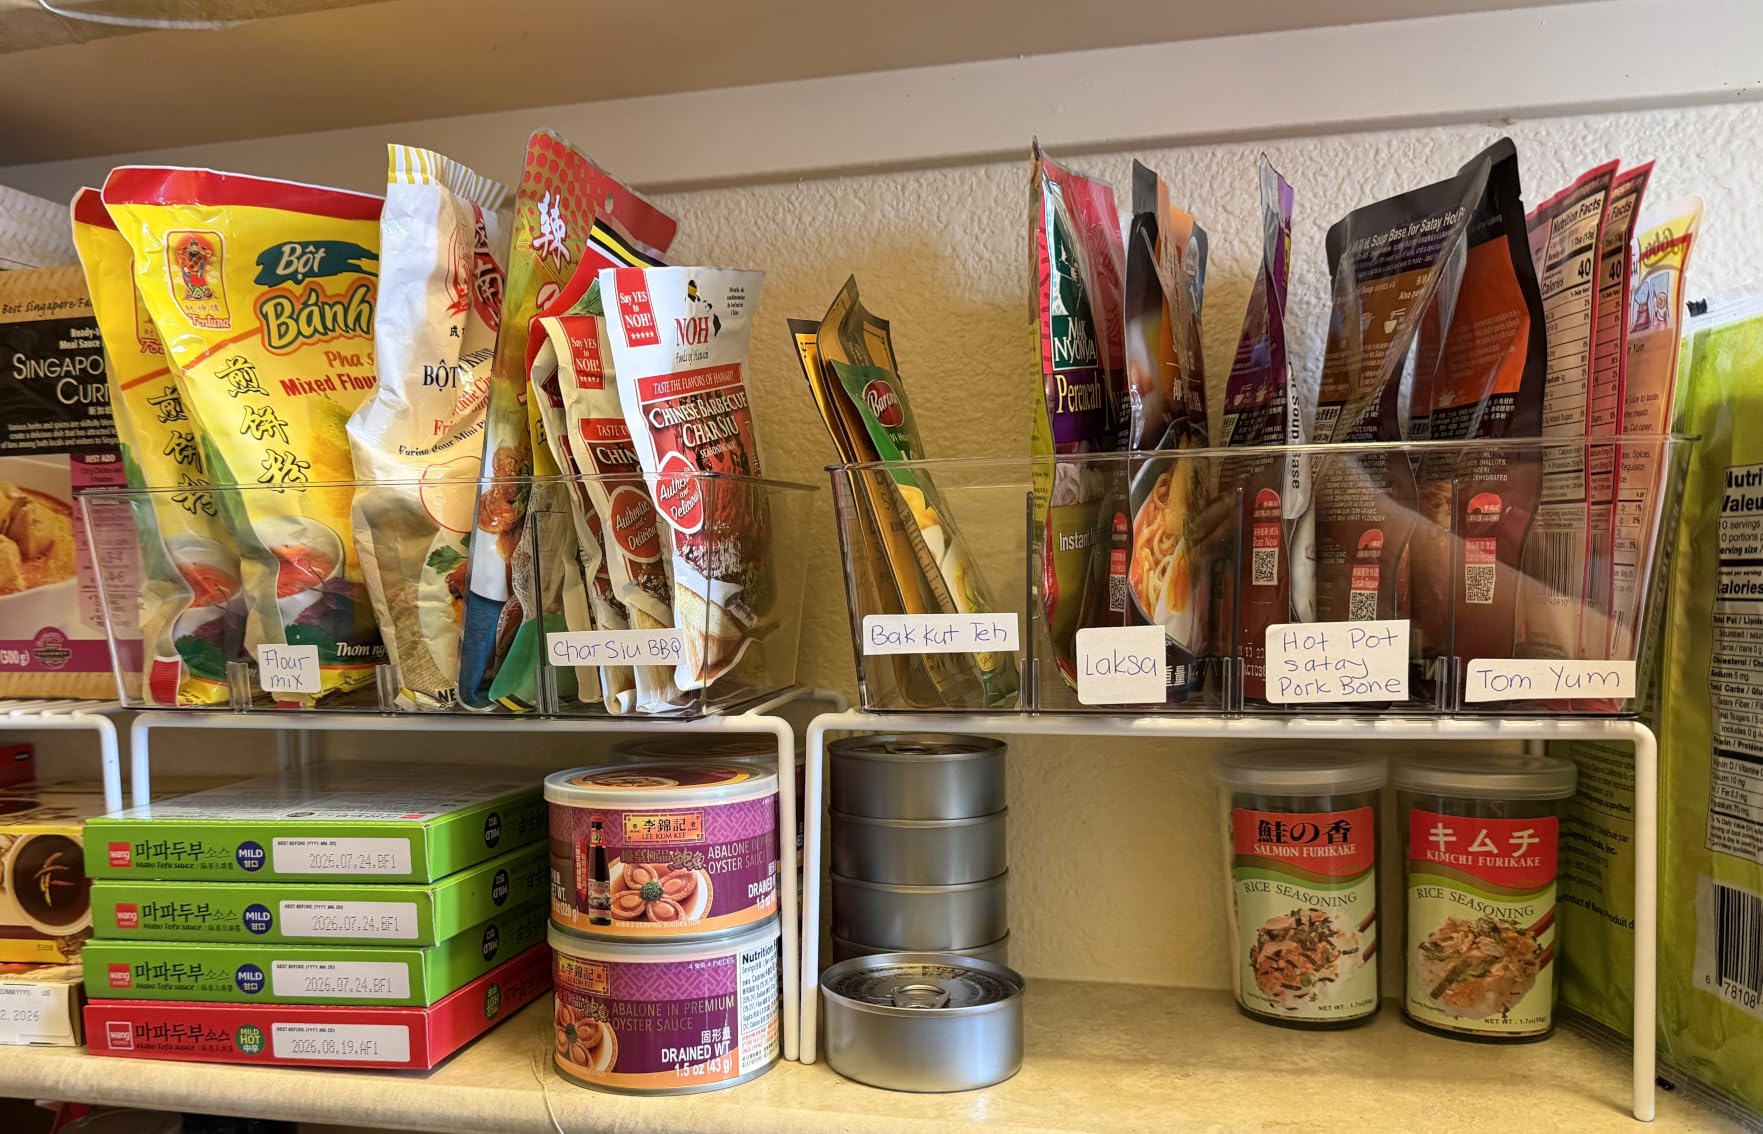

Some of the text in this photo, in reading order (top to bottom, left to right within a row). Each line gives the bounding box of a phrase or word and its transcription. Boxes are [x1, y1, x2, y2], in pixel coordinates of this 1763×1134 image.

[1579, 198, 1601, 217] Facts
[1612, 201, 1632, 217] Facts
[1388, 226, 1407, 241] Base
[1407, 222, 1420, 236] for
[1420, 215, 1442, 232] Satay
[276, 244, 326, 280] Bột
[1578, 257, 1591, 278] 40
[1609, 259, 1622, 280] 40
[620, 291, 648, 304] Say YES
[2, 300, 77, 318] Best Singapore
[260, 284, 373, 350] Bánh
[632, 304, 640, 312] to
[625, 313, 654, 328] NOH!
[674, 316, 709, 347] NOH
[571, 337, 597, 349] Say YES
[326, 348, 363, 369] Pha
[576, 359, 601, 372] NOH!
[281, 377, 337, 397] Mixed
[653, 374, 713, 395] TASTE THE FLAVORS OF
[1291, 396, 1301, 440] Soup
[596, 423, 620, 437] TASTE
[615, 499, 649, 532] Authentic
[1729, 520, 1761, 531] servings
[1728, 532, 1759, 542] portions
[871, 624, 916, 646] Bak
[970, 621, 1008, 643] Teh
[1283, 627, 1399, 652] Hot Pot
[336, 641, 370, 658] Thơm
[605, 640, 642, 659] Siu
[648, 637, 682, 660] BBQ
[264, 650, 311, 670] Flour
[1084, 649, 1157, 676] Laksa
[271, 675, 304, 690] mix
[1476, 665, 1621, 692] Tom Yum
[1739, 673, 1749, 681] mg
[1278, 676, 1401, 697] Pork Bone
[642, 818, 686, 833] 李錦記
[1257, 819, 1353, 845] 鮭の香
[641, 832, 687, 840] LEE KUM KEE
[1428, 822, 1541, 858] キムチ
[109, 849, 130, 861] wang
[238, 849, 263, 858] MILD
[707, 843, 750, 859] ABALONE
[1253, 843, 1357, 858] SALMON FURIKAKE
[1426, 849, 1542, 868] KIMCHI FURIKAKE
[708, 852, 767, 875] OYSTER SAUCE
[1243, 881, 1357, 908] RICE SEASONING
[1416, 887, 1534, 919] RICE SEASONING
[116, 911, 137, 922] wang
[246, 911, 270, 921] MILD
[712, 957, 735, 967] PIECES
[742, 944, 773, 965] Nutrition
[109, 970, 130, 982] wang
[238, 971, 263, 981] MILD
[1705, 975, 1757, 1010] 6 78108
[612, 994, 735, 1017] ABALONE IN PREMIUM
[13, 1010, 40, 1022] 2026
[612, 1017, 693, 1032] OYSTER SAUCE
[109, 1030, 130, 1042] wang
[240, 1028, 259, 1036] MILD
[240, 1035, 261, 1045] HOT
[701, 1026, 732, 1044] 固形量
[661, 1043, 712, 1063] DRAINED
[674, 1058, 732, 1078] 1.5 oz (43 g)
